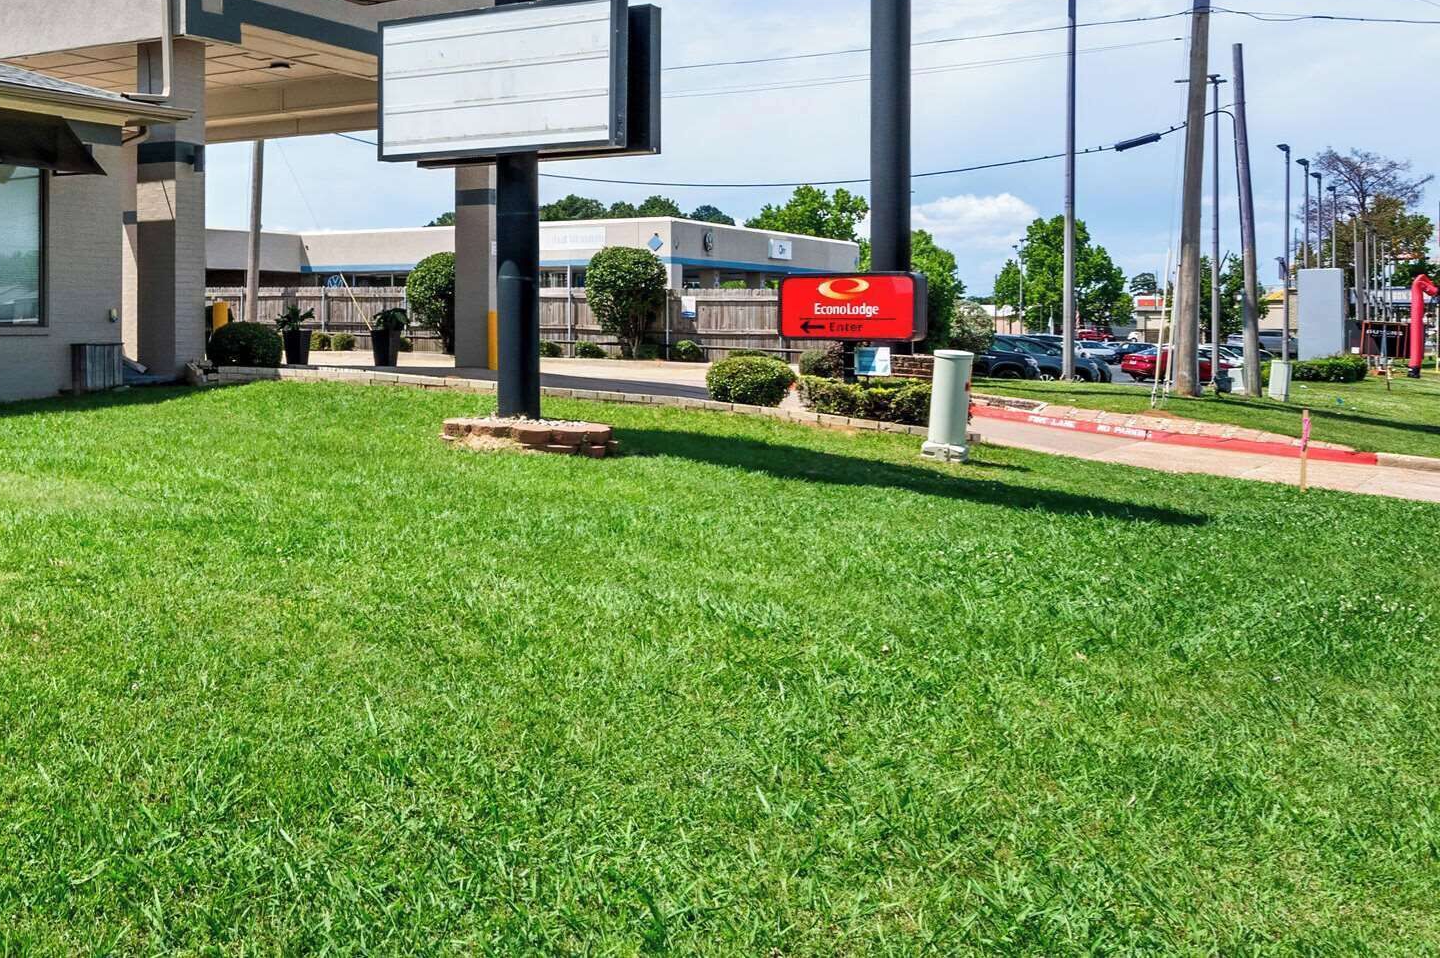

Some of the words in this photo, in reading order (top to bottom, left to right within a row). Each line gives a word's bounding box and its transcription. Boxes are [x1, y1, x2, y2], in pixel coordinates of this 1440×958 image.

[814, 302, 880, 318] EconoLodge
[829, 322, 864, 333] Enter
[1051, 418, 1075, 428] LANE
[1097, 424, 1111, 432] NO
